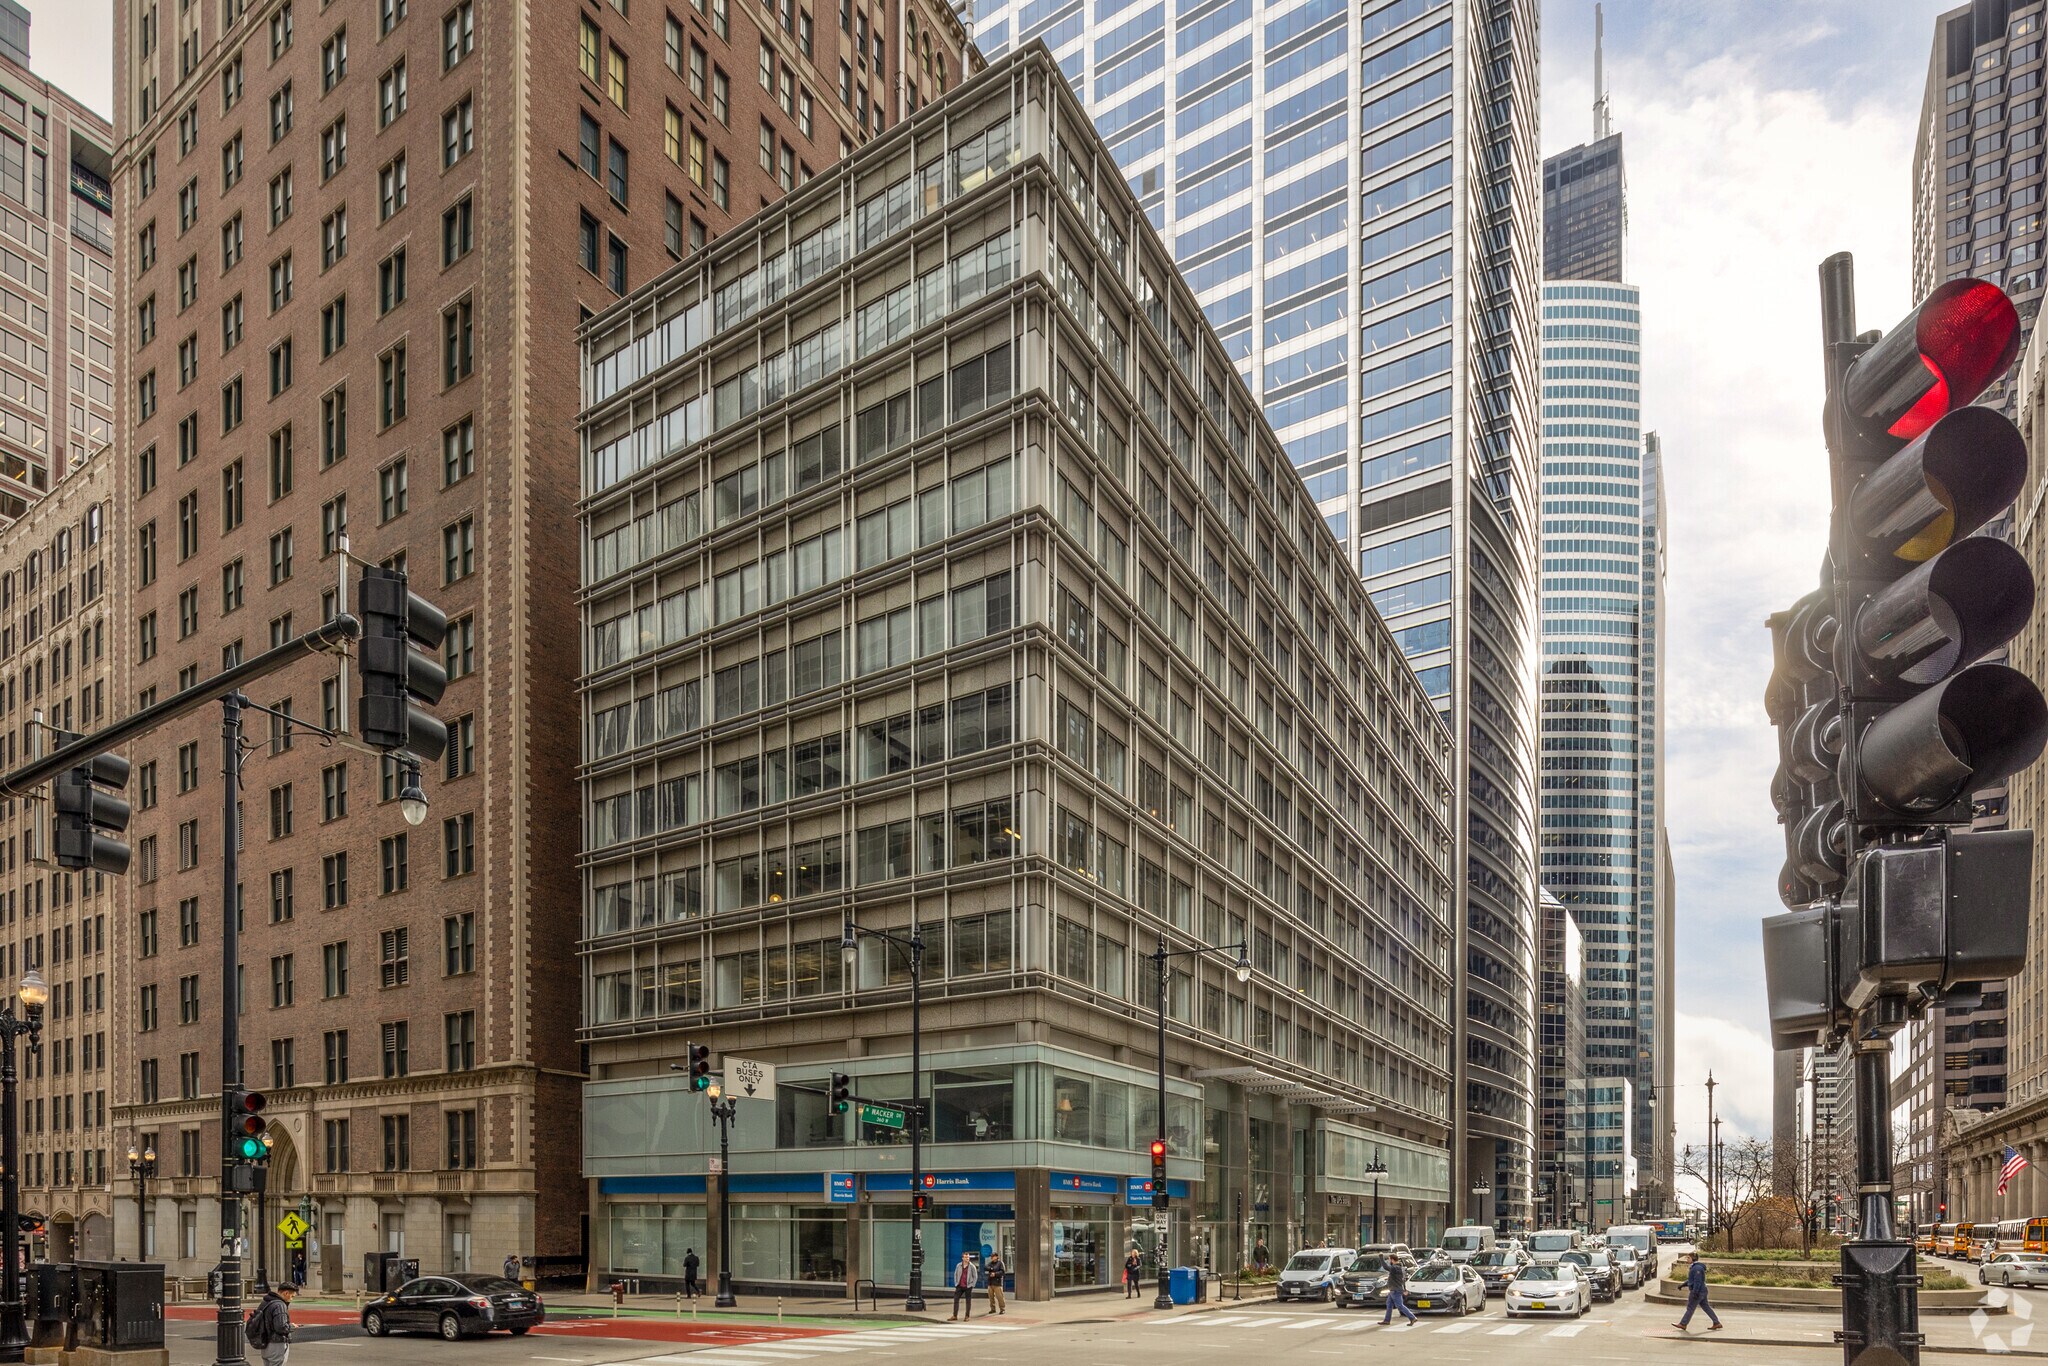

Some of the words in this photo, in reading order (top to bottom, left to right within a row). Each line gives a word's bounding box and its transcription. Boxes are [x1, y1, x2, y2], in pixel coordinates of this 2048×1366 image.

[742, 1061, 757, 1069] CTA
[736, 1067, 764, 1077] BUSES
[738, 1075, 761, 1084] ONLY
[871, 1108, 894, 1119] WACKER
